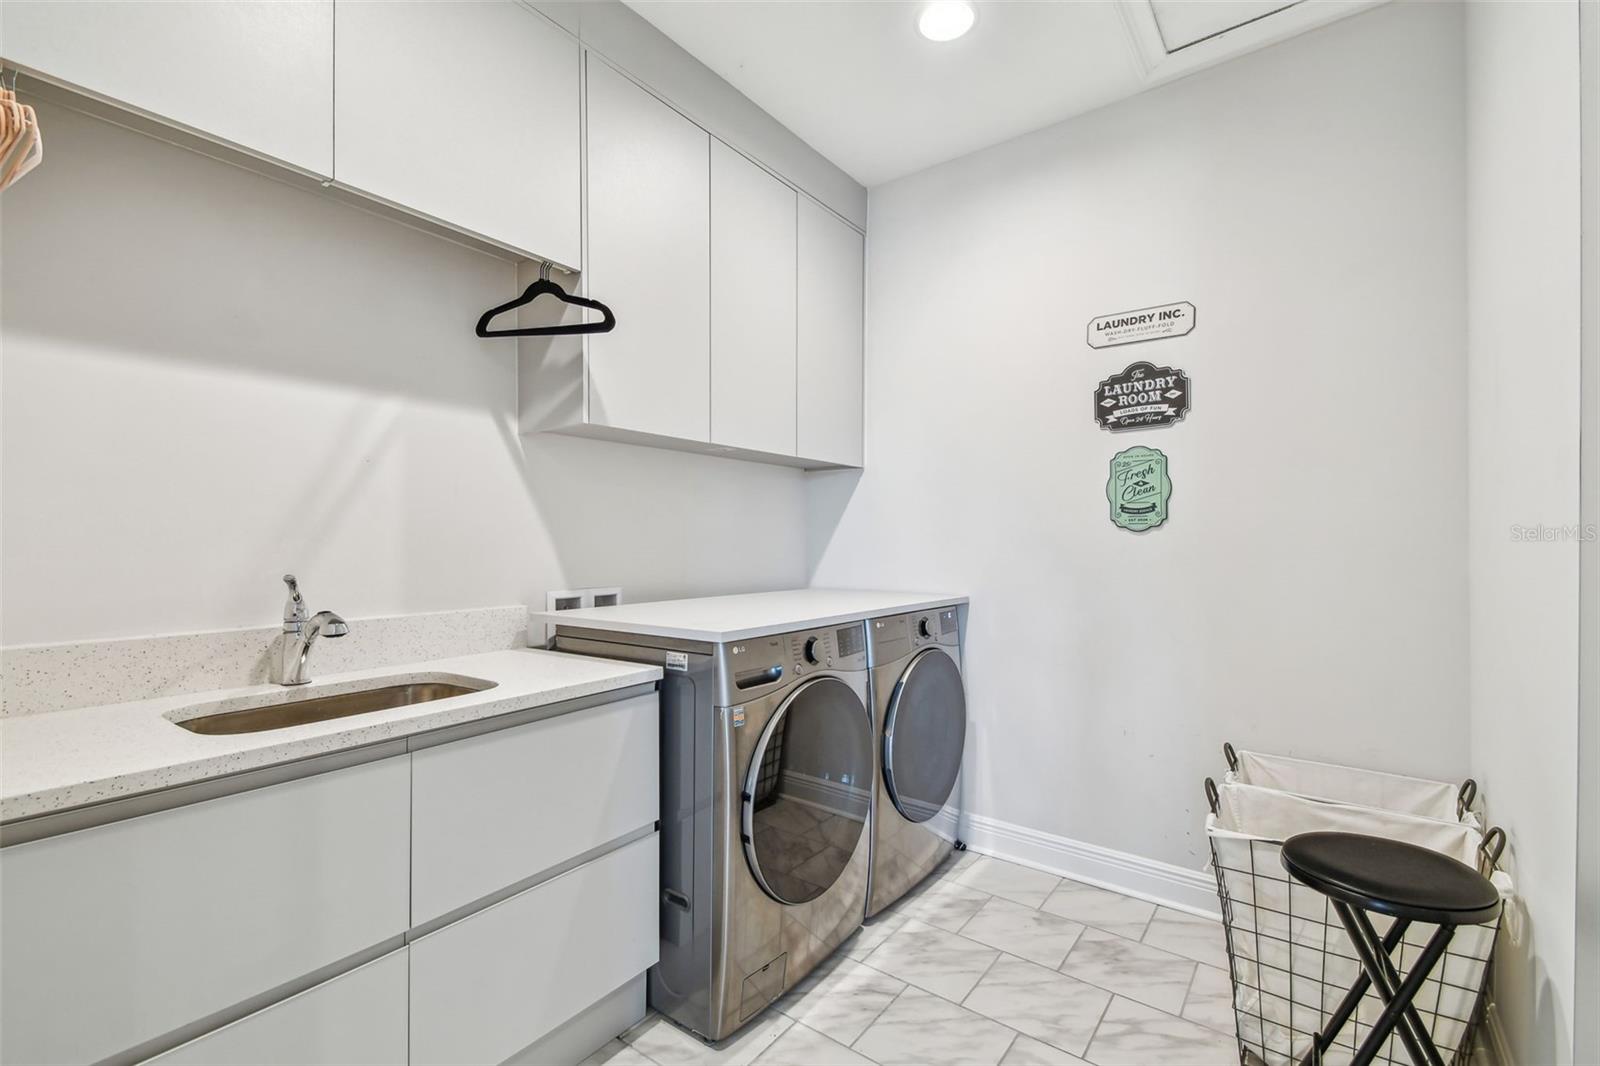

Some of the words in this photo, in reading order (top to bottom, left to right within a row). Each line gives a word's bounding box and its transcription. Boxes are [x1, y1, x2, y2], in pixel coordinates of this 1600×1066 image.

[1096, 313, 1156, 331] LAUNDRY
[1158, 309, 1185, 321] INC.
[1104, 375, 1178, 396] LAUNDRY
[1118, 390, 1163, 407] ROOM
[1117, 463, 1156, 487] Fresh
[1121, 484, 1156, 502] Clean
